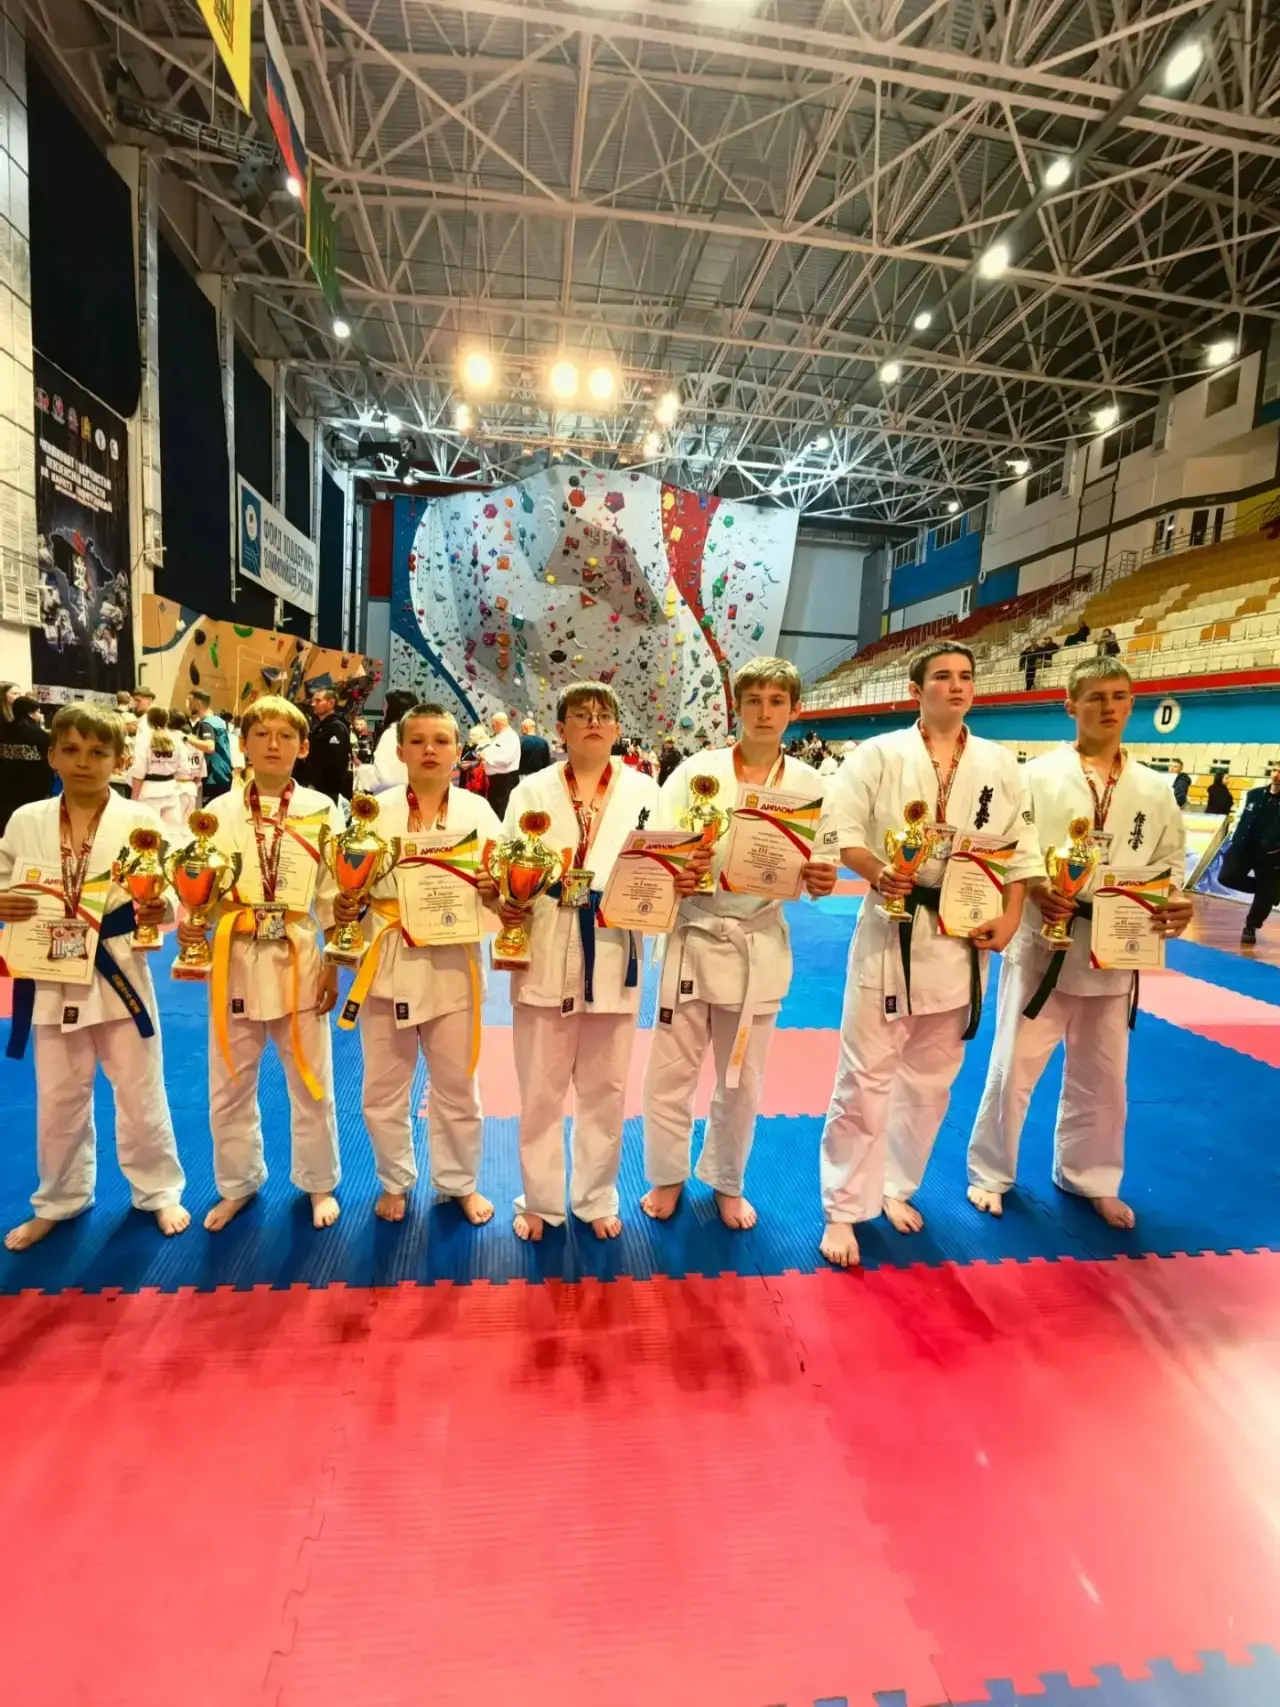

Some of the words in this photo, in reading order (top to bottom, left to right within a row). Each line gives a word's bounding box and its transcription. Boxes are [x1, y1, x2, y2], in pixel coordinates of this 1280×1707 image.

[1161, 706, 1173, 725] D
[760, 803, 794, 814] ДИПЛОМ
[420, 846, 453, 855] ДИПЛОМ
